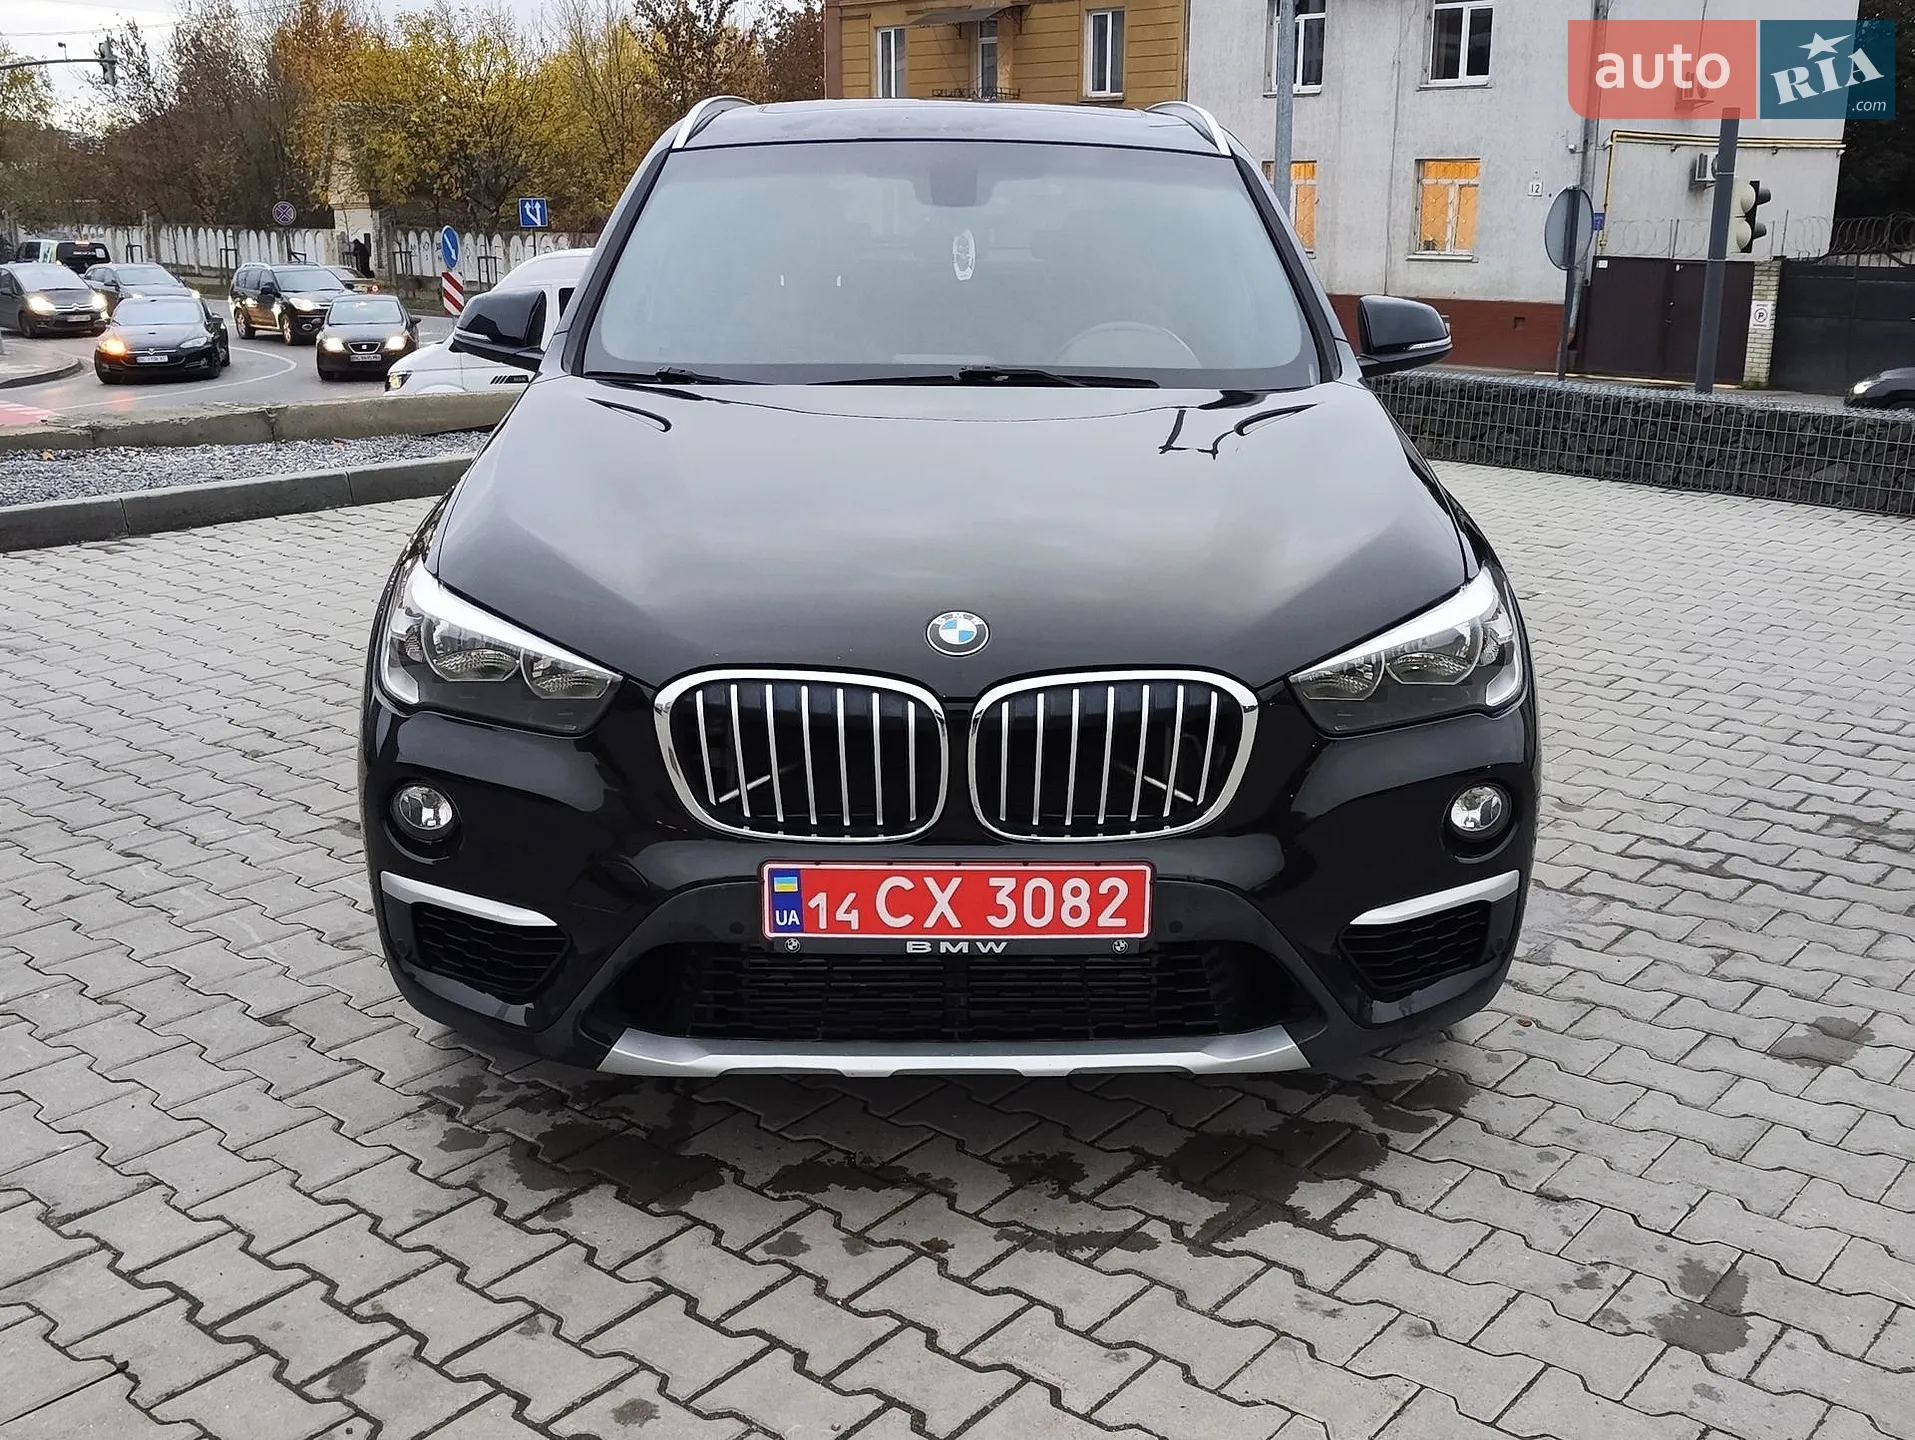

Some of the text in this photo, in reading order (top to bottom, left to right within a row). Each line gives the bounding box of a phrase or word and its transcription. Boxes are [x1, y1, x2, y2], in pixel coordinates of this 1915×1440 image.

[1531, 184, 1540, 193] 12
[807, 876, 1129, 930] 14 CX 3082
[775, 910, 800, 926] UA
[906, 941, 1008, 953] BMW
